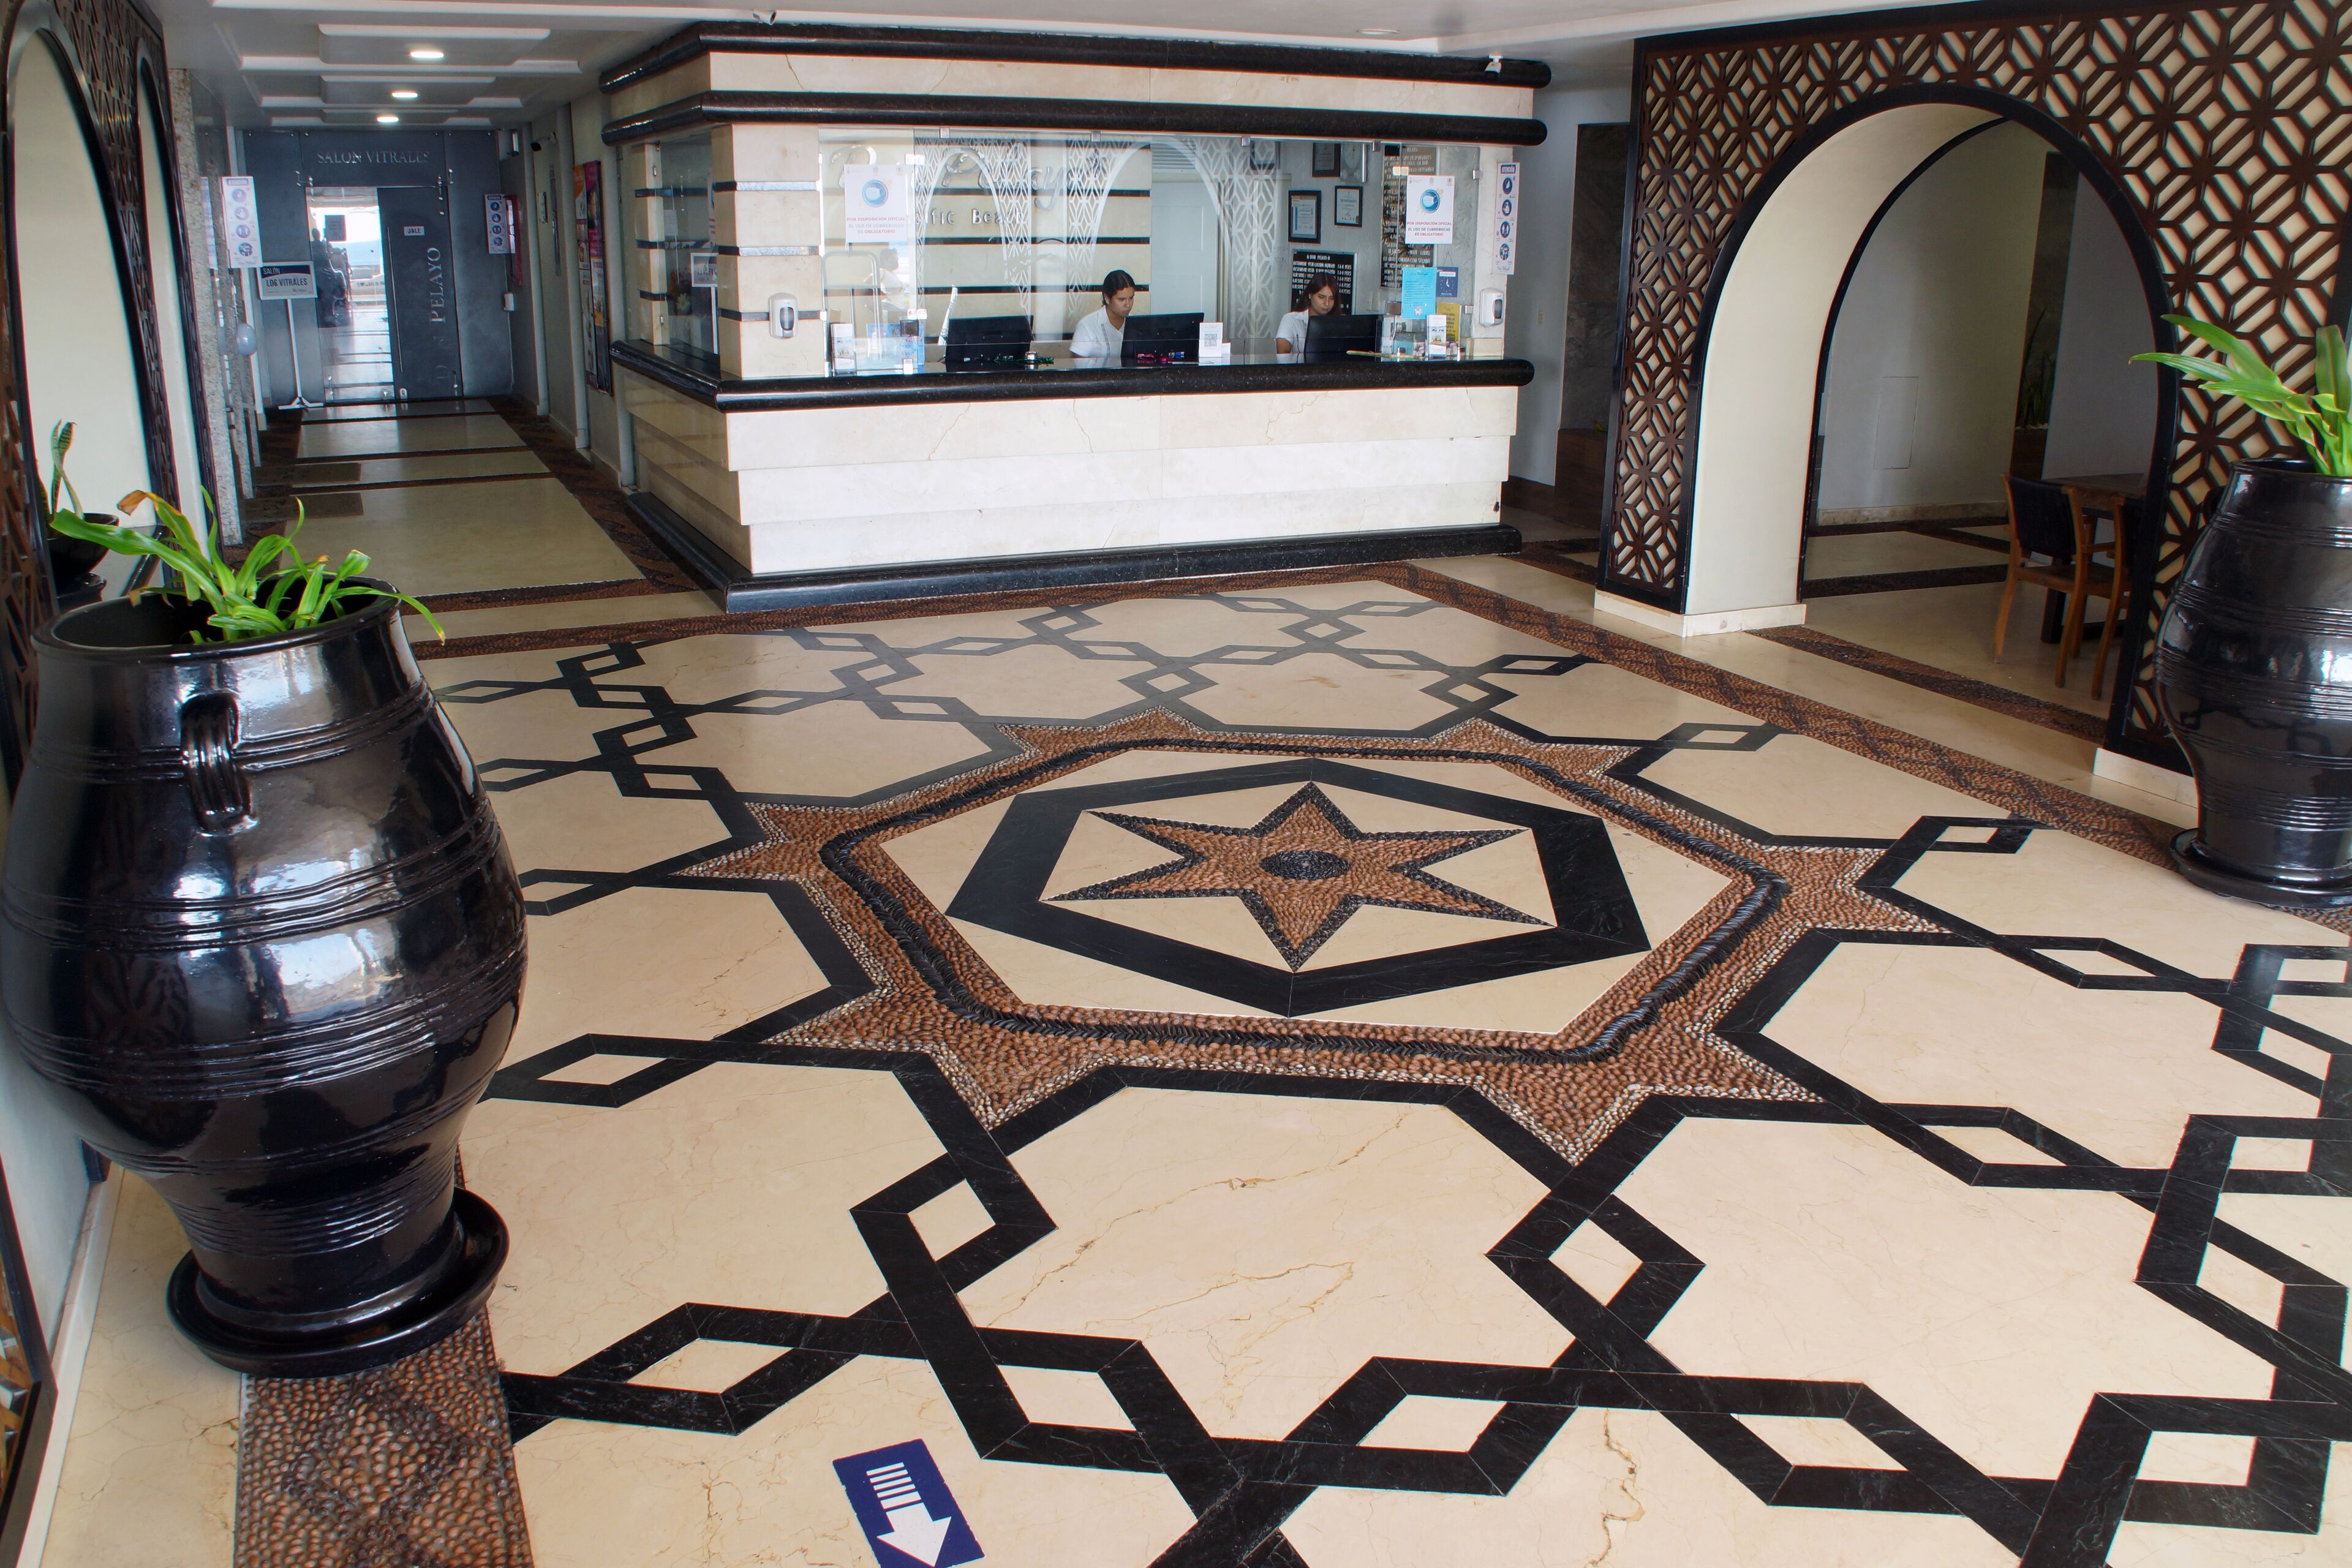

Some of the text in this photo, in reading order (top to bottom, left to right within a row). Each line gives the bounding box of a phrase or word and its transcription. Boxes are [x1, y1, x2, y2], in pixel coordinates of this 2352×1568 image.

[317, 151, 429, 164] SALON VITRALES
[263, 266, 281, 275] SALÓN
[266, 278, 308, 287] LOS VITRALES
[427, 247, 446, 323] PELAYO
